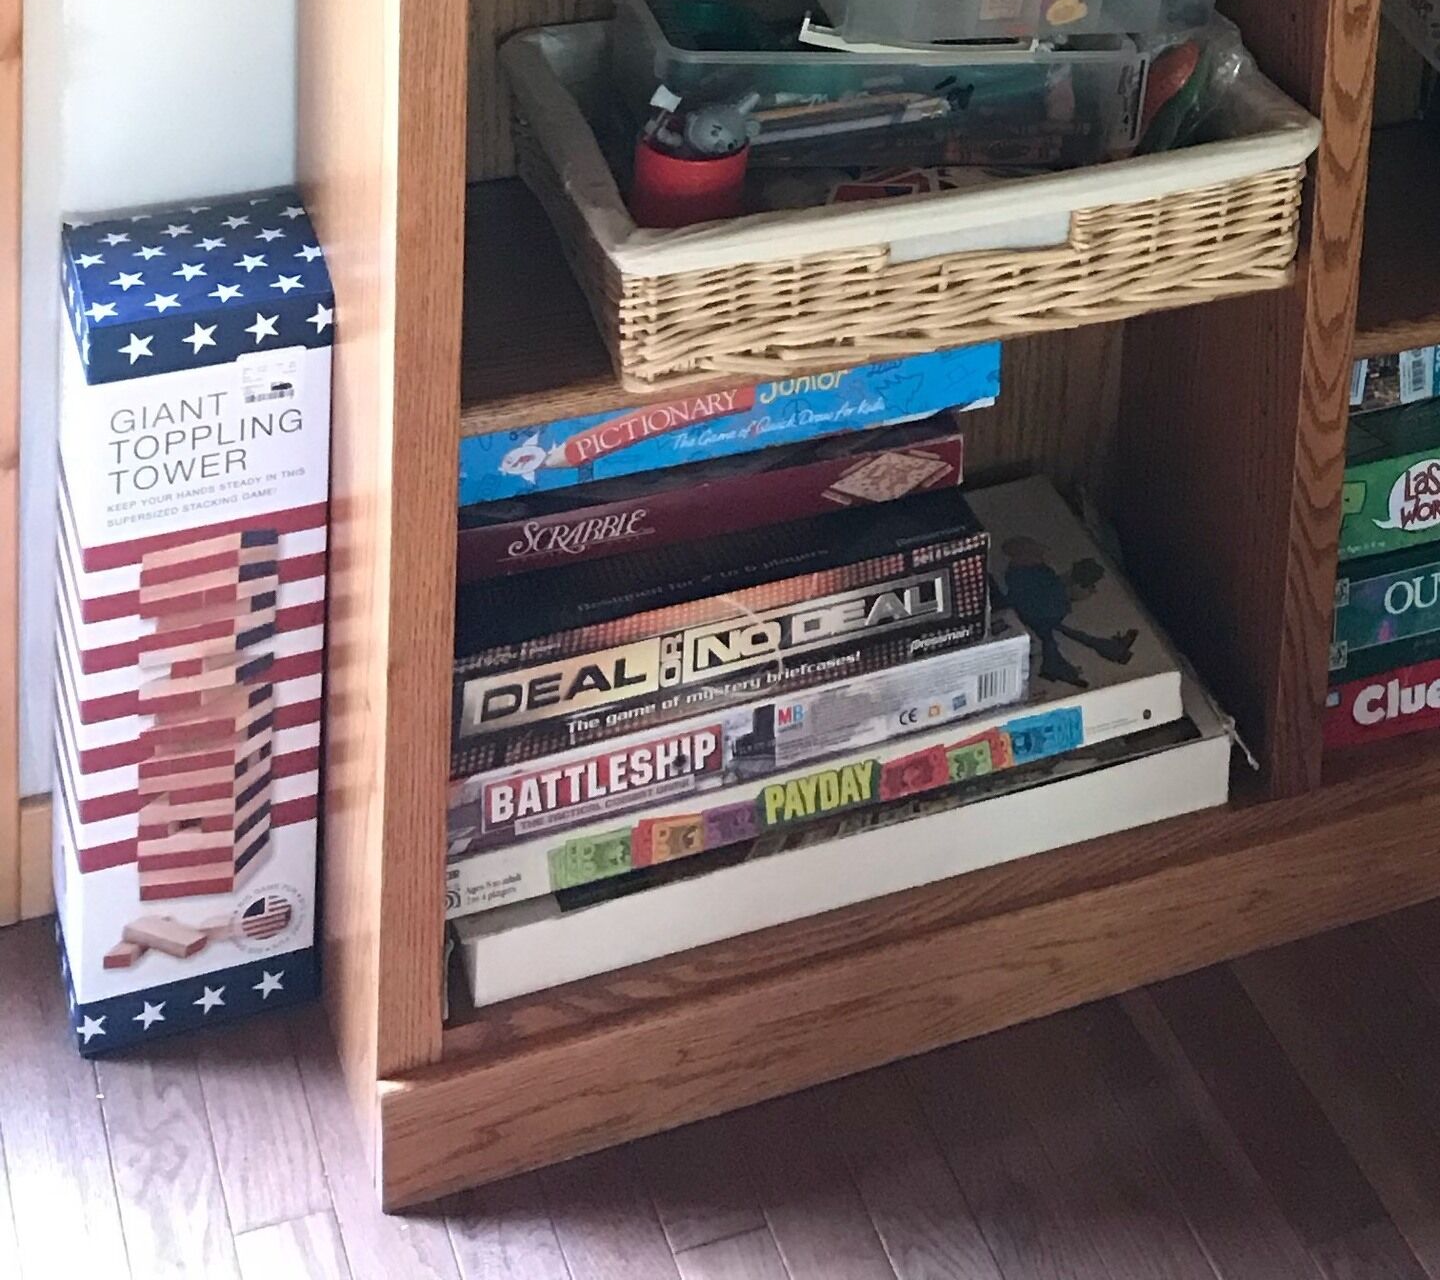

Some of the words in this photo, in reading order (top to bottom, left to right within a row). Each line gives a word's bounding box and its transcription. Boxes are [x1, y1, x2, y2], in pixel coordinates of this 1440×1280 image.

[108, 408, 303, 464] TOPPLING
[110, 391, 228, 434] GIANT
[574, 389, 739, 462] PICTIONARY
[106, 500, 137, 512] KEEP
[141, 493, 173, 507] YOUR
[176, 485, 216, 500] HANDS
[219, 477, 262, 491] STEADY
[265, 473, 277, 482] IN
[280, 467, 306, 479] THIS
[107, 448, 247, 495] TOWER
[106, 507, 179, 528] SUPERSIZED
[181, 494, 238, 513] STACKING
[242, 487, 278, 501] GAME!
[506, 507, 650, 558] SCRABBLE
[480, 657, 647, 723] DEAL
[660, 633, 683, 688] OR
[696, 622, 781, 670] NO
[793, 576, 943, 638] DEAL
[565, 716, 600, 736] The
[606, 703, 656, 727] game
[661, 695, 682, 710] of
[686, 676, 762, 705] mystery
[765, 649, 862, 685] briefcases!
[777, 705, 805, 726] MB
[489, 731, 717, 824] BATTLESHIP
[762, 759, 879, 826] PAYDAY
